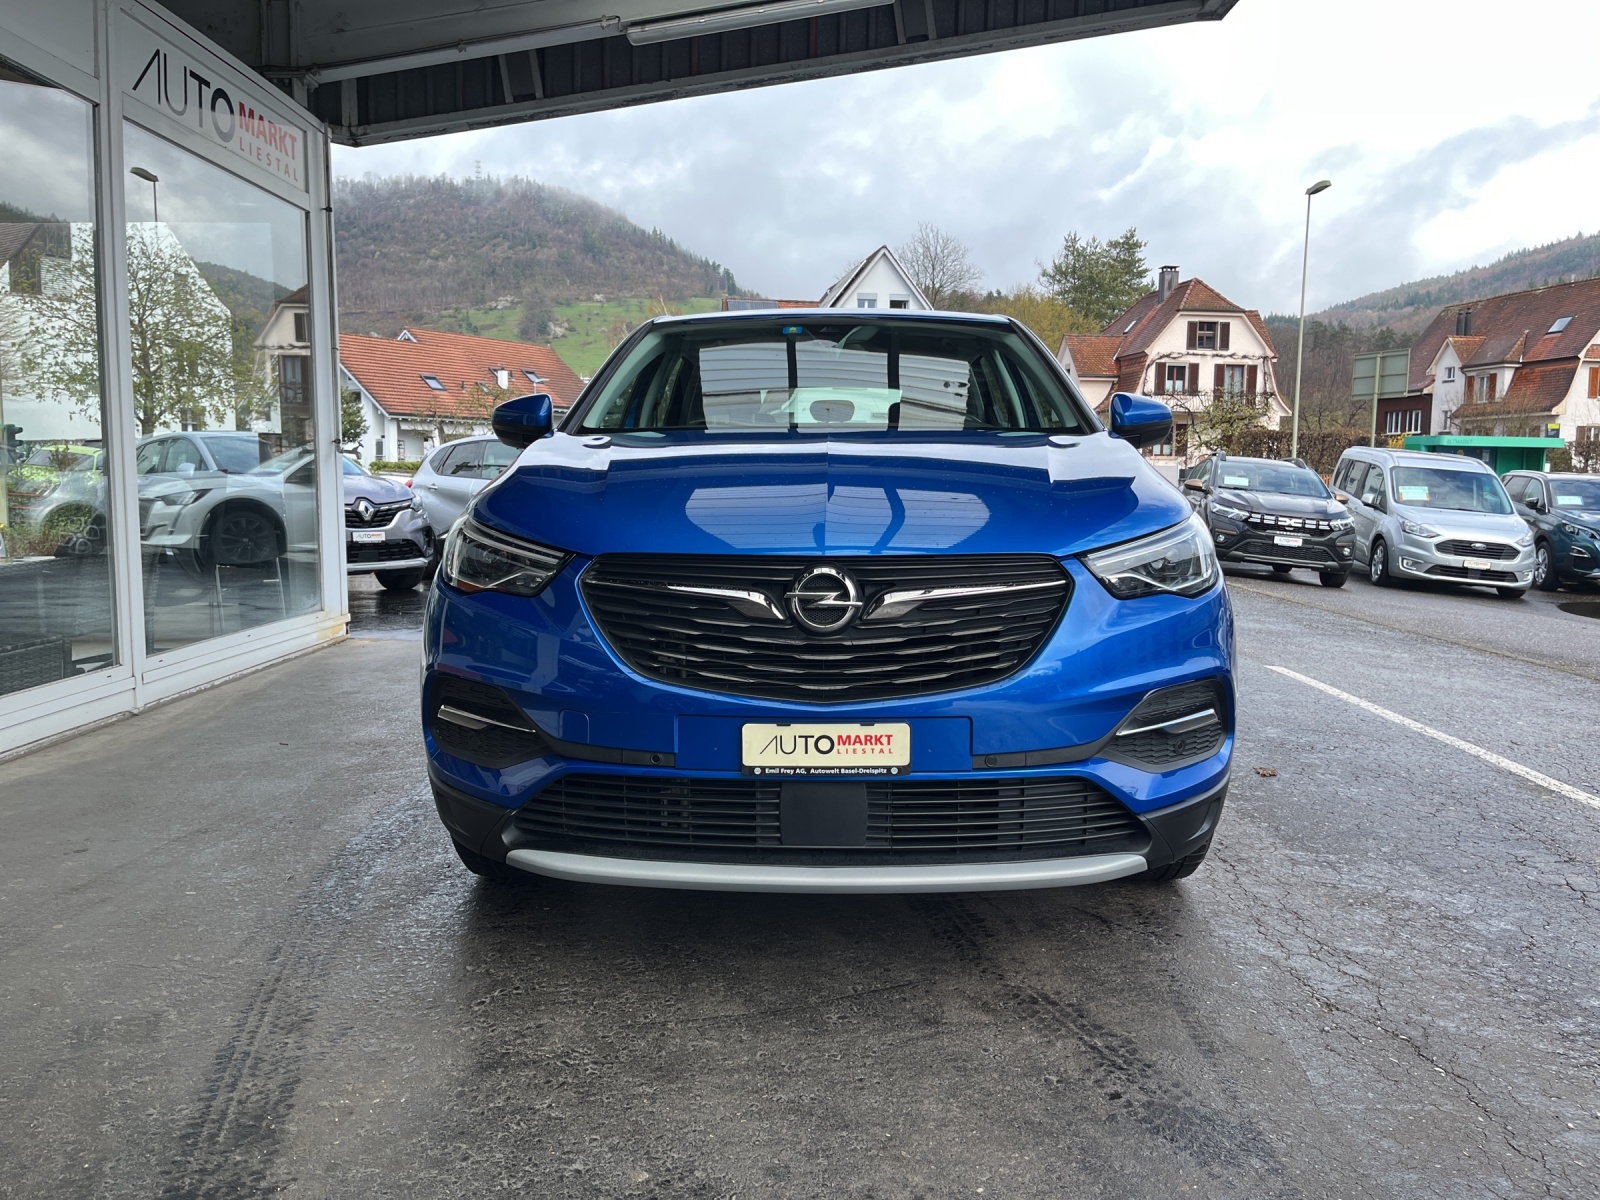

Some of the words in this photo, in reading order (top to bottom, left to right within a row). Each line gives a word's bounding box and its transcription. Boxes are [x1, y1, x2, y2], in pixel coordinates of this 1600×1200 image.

[131, 48, 236, 143] AUTO
[239, 101, 297, 160] MARKT
[239, 137, 298, 181] LIESTAL
[760, 734, 835, 755] AUTO
[837, 734, 893, 746] MARKT
[780, 767, 794, 775] Frey
[840, 767, 887, 775] Basel-Dreispitz
